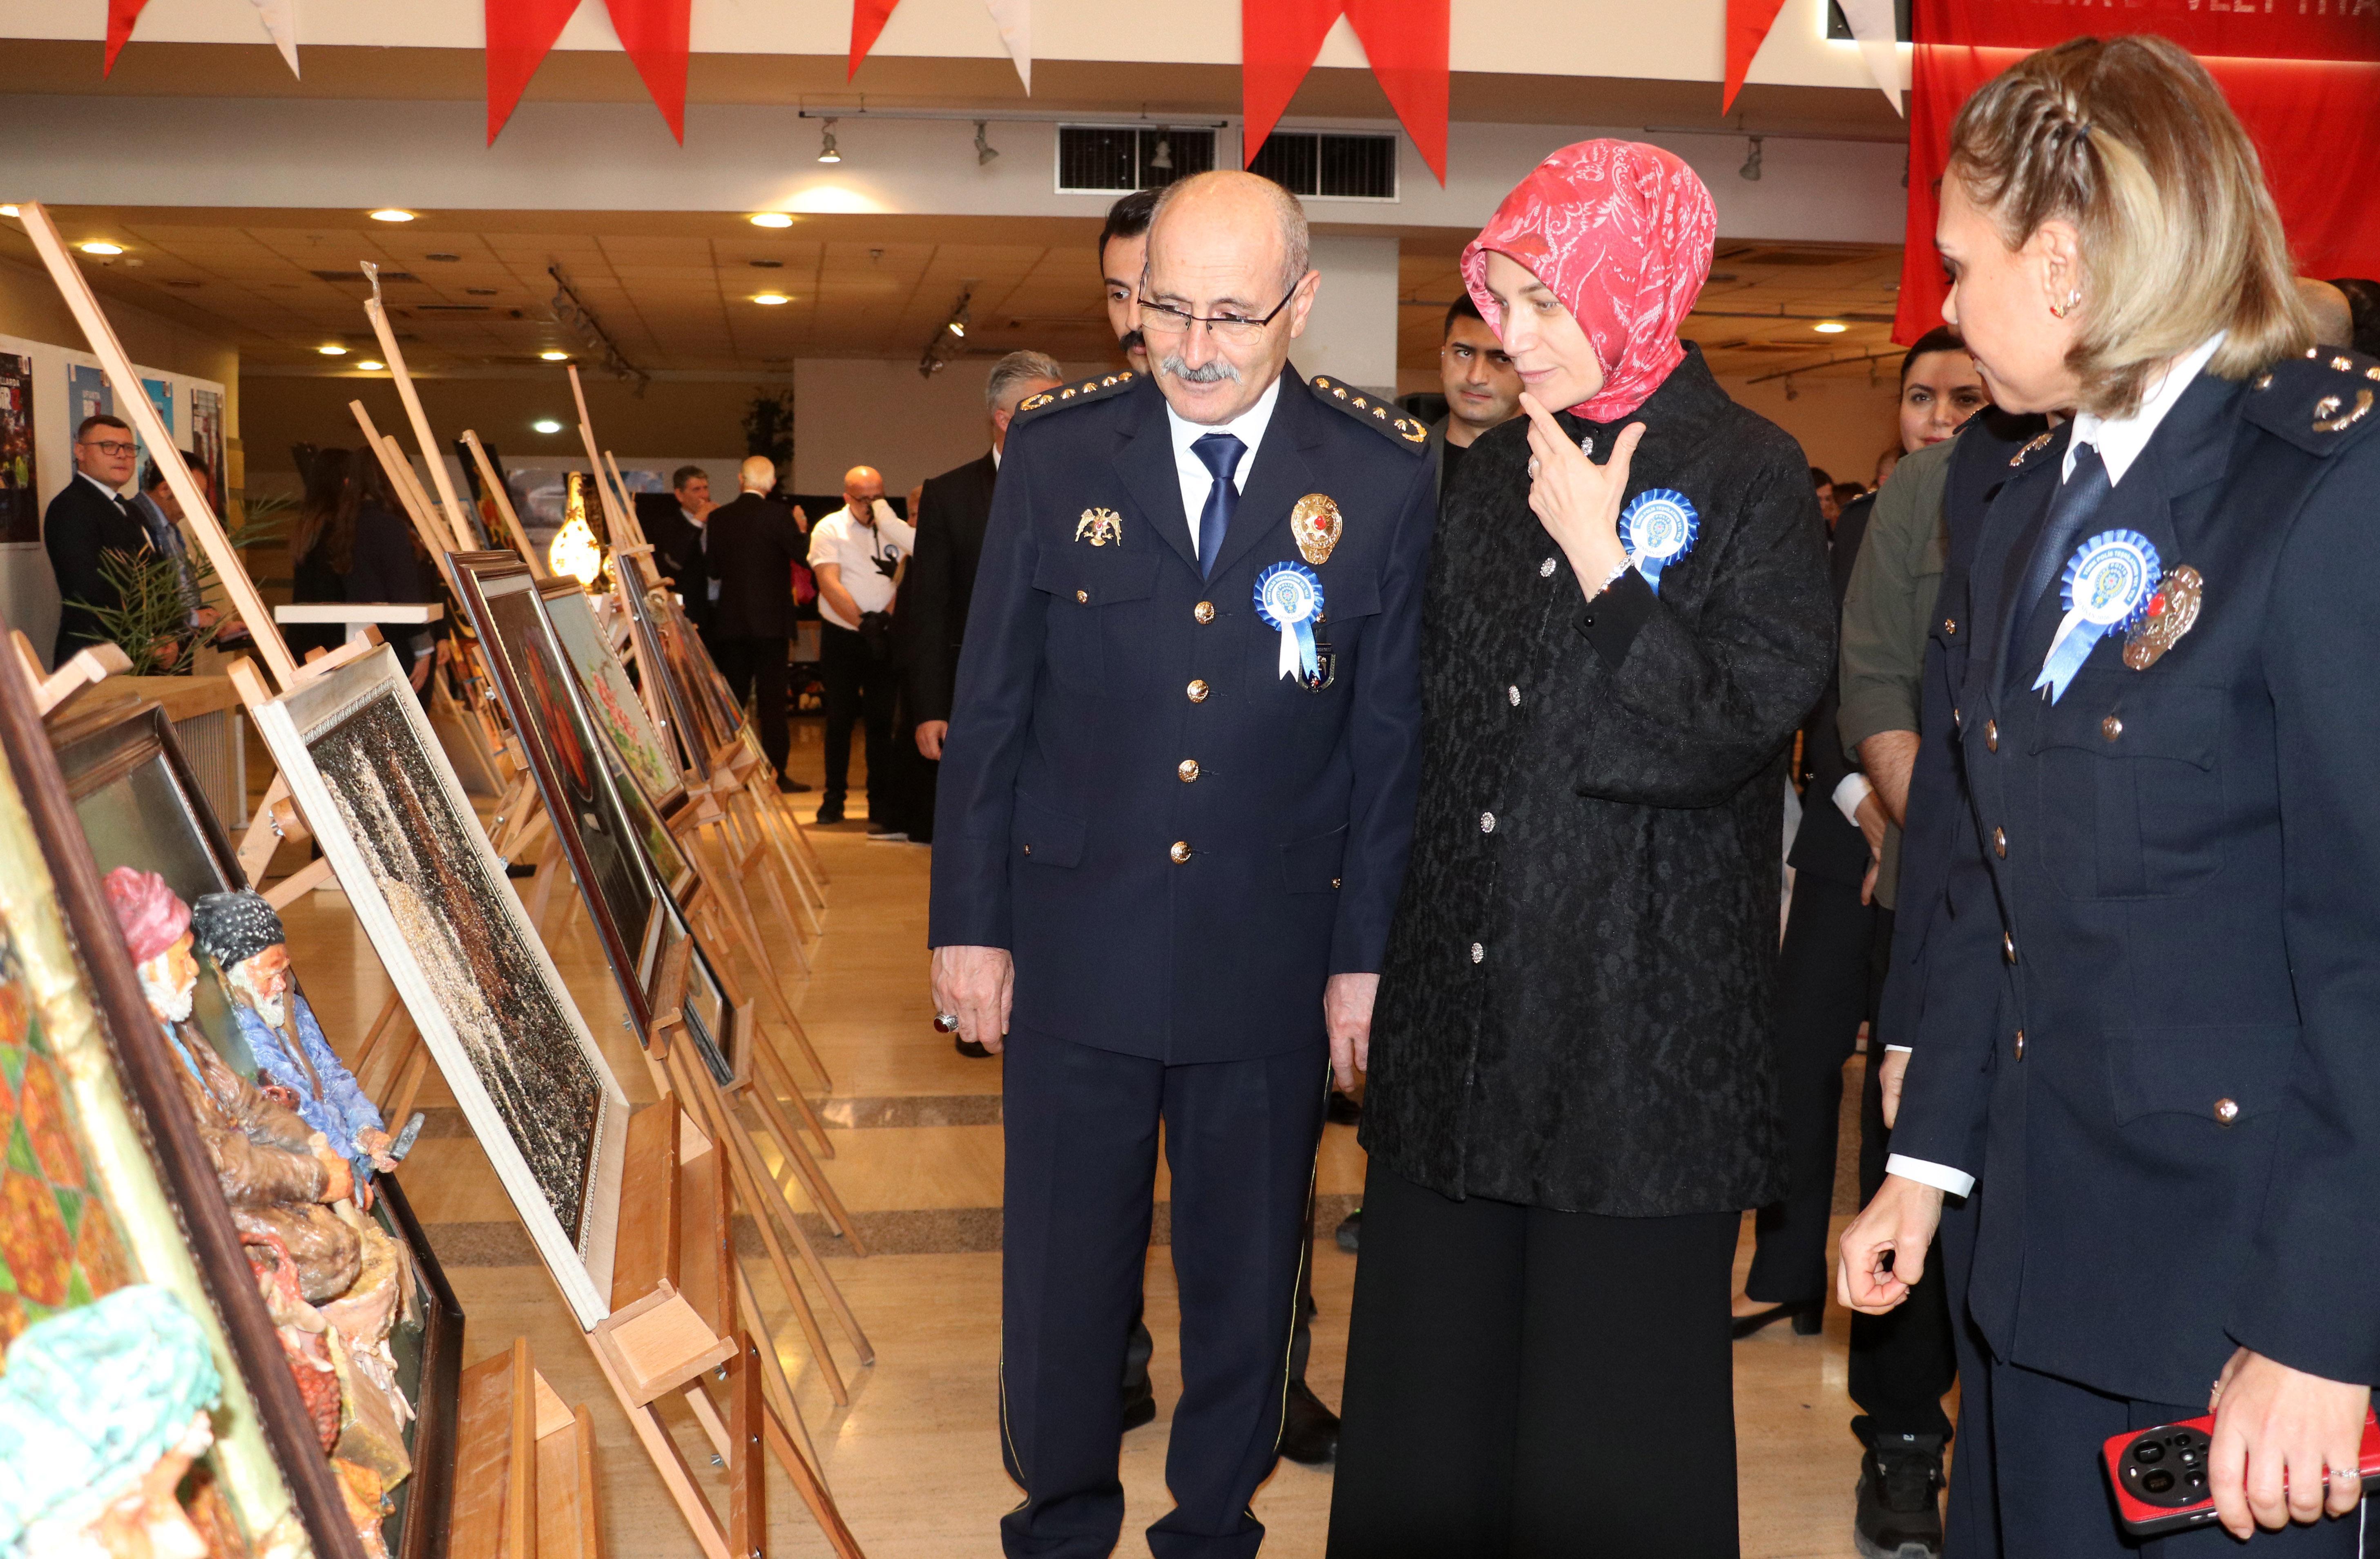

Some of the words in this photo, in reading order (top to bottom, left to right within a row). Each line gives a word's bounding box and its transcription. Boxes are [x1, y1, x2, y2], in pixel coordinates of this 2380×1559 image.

[1643, 507, 1656, 516] POLİS
[2096, 551, 2113, 562] POLİS
[2110, 563, 2127, 575] POLİS
[1268, 581, 1277, 592] POLİS
